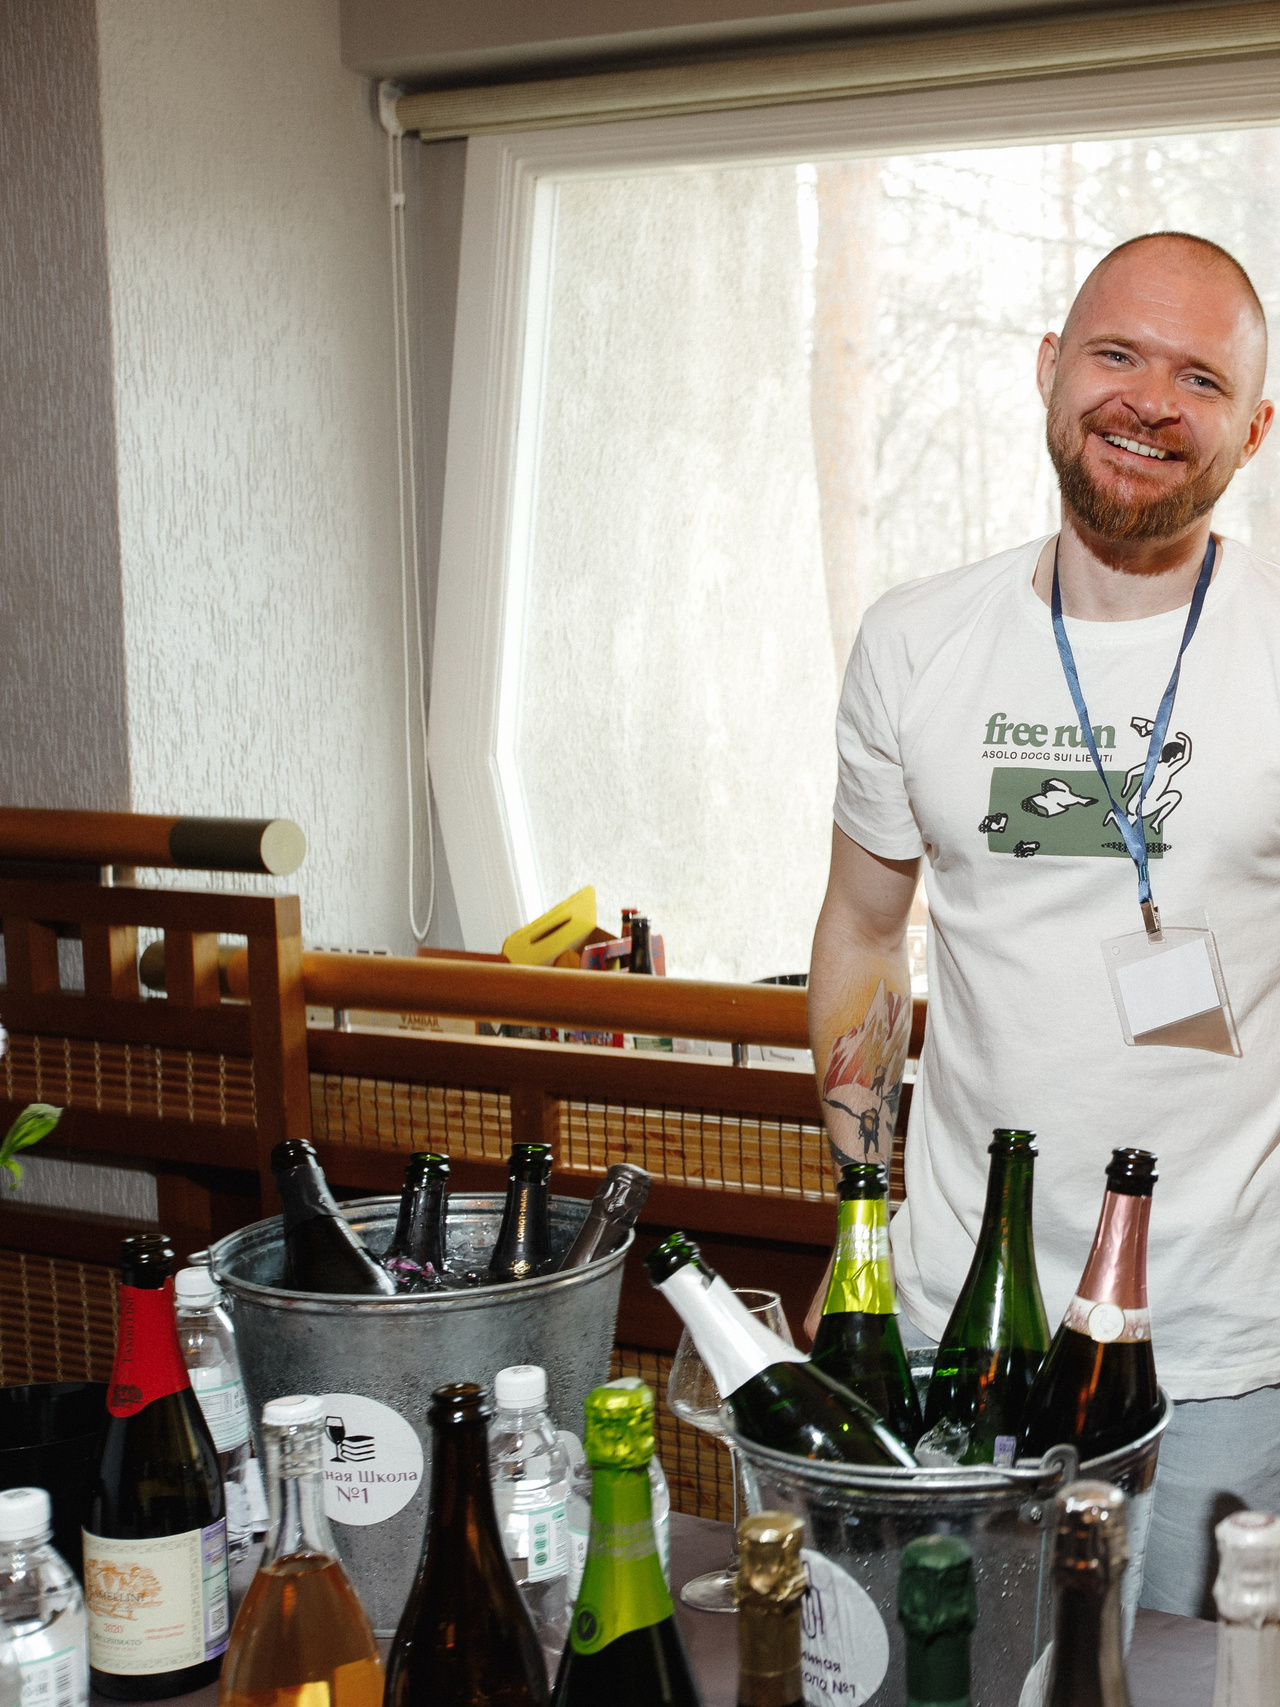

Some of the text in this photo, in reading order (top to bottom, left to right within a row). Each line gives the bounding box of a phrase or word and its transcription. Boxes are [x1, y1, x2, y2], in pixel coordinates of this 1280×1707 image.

[982, 712, 1117, 749] free run
[981, 750, 1113, 763] ASOLO DOCG SUI LIEITI
[323, 1470, 418, 1484] ная Школа
[335, 1484, 369, 1505] №1
[801, 1650, 842, 1674] инная
[803, 1671, 856, 1699] ола №1
